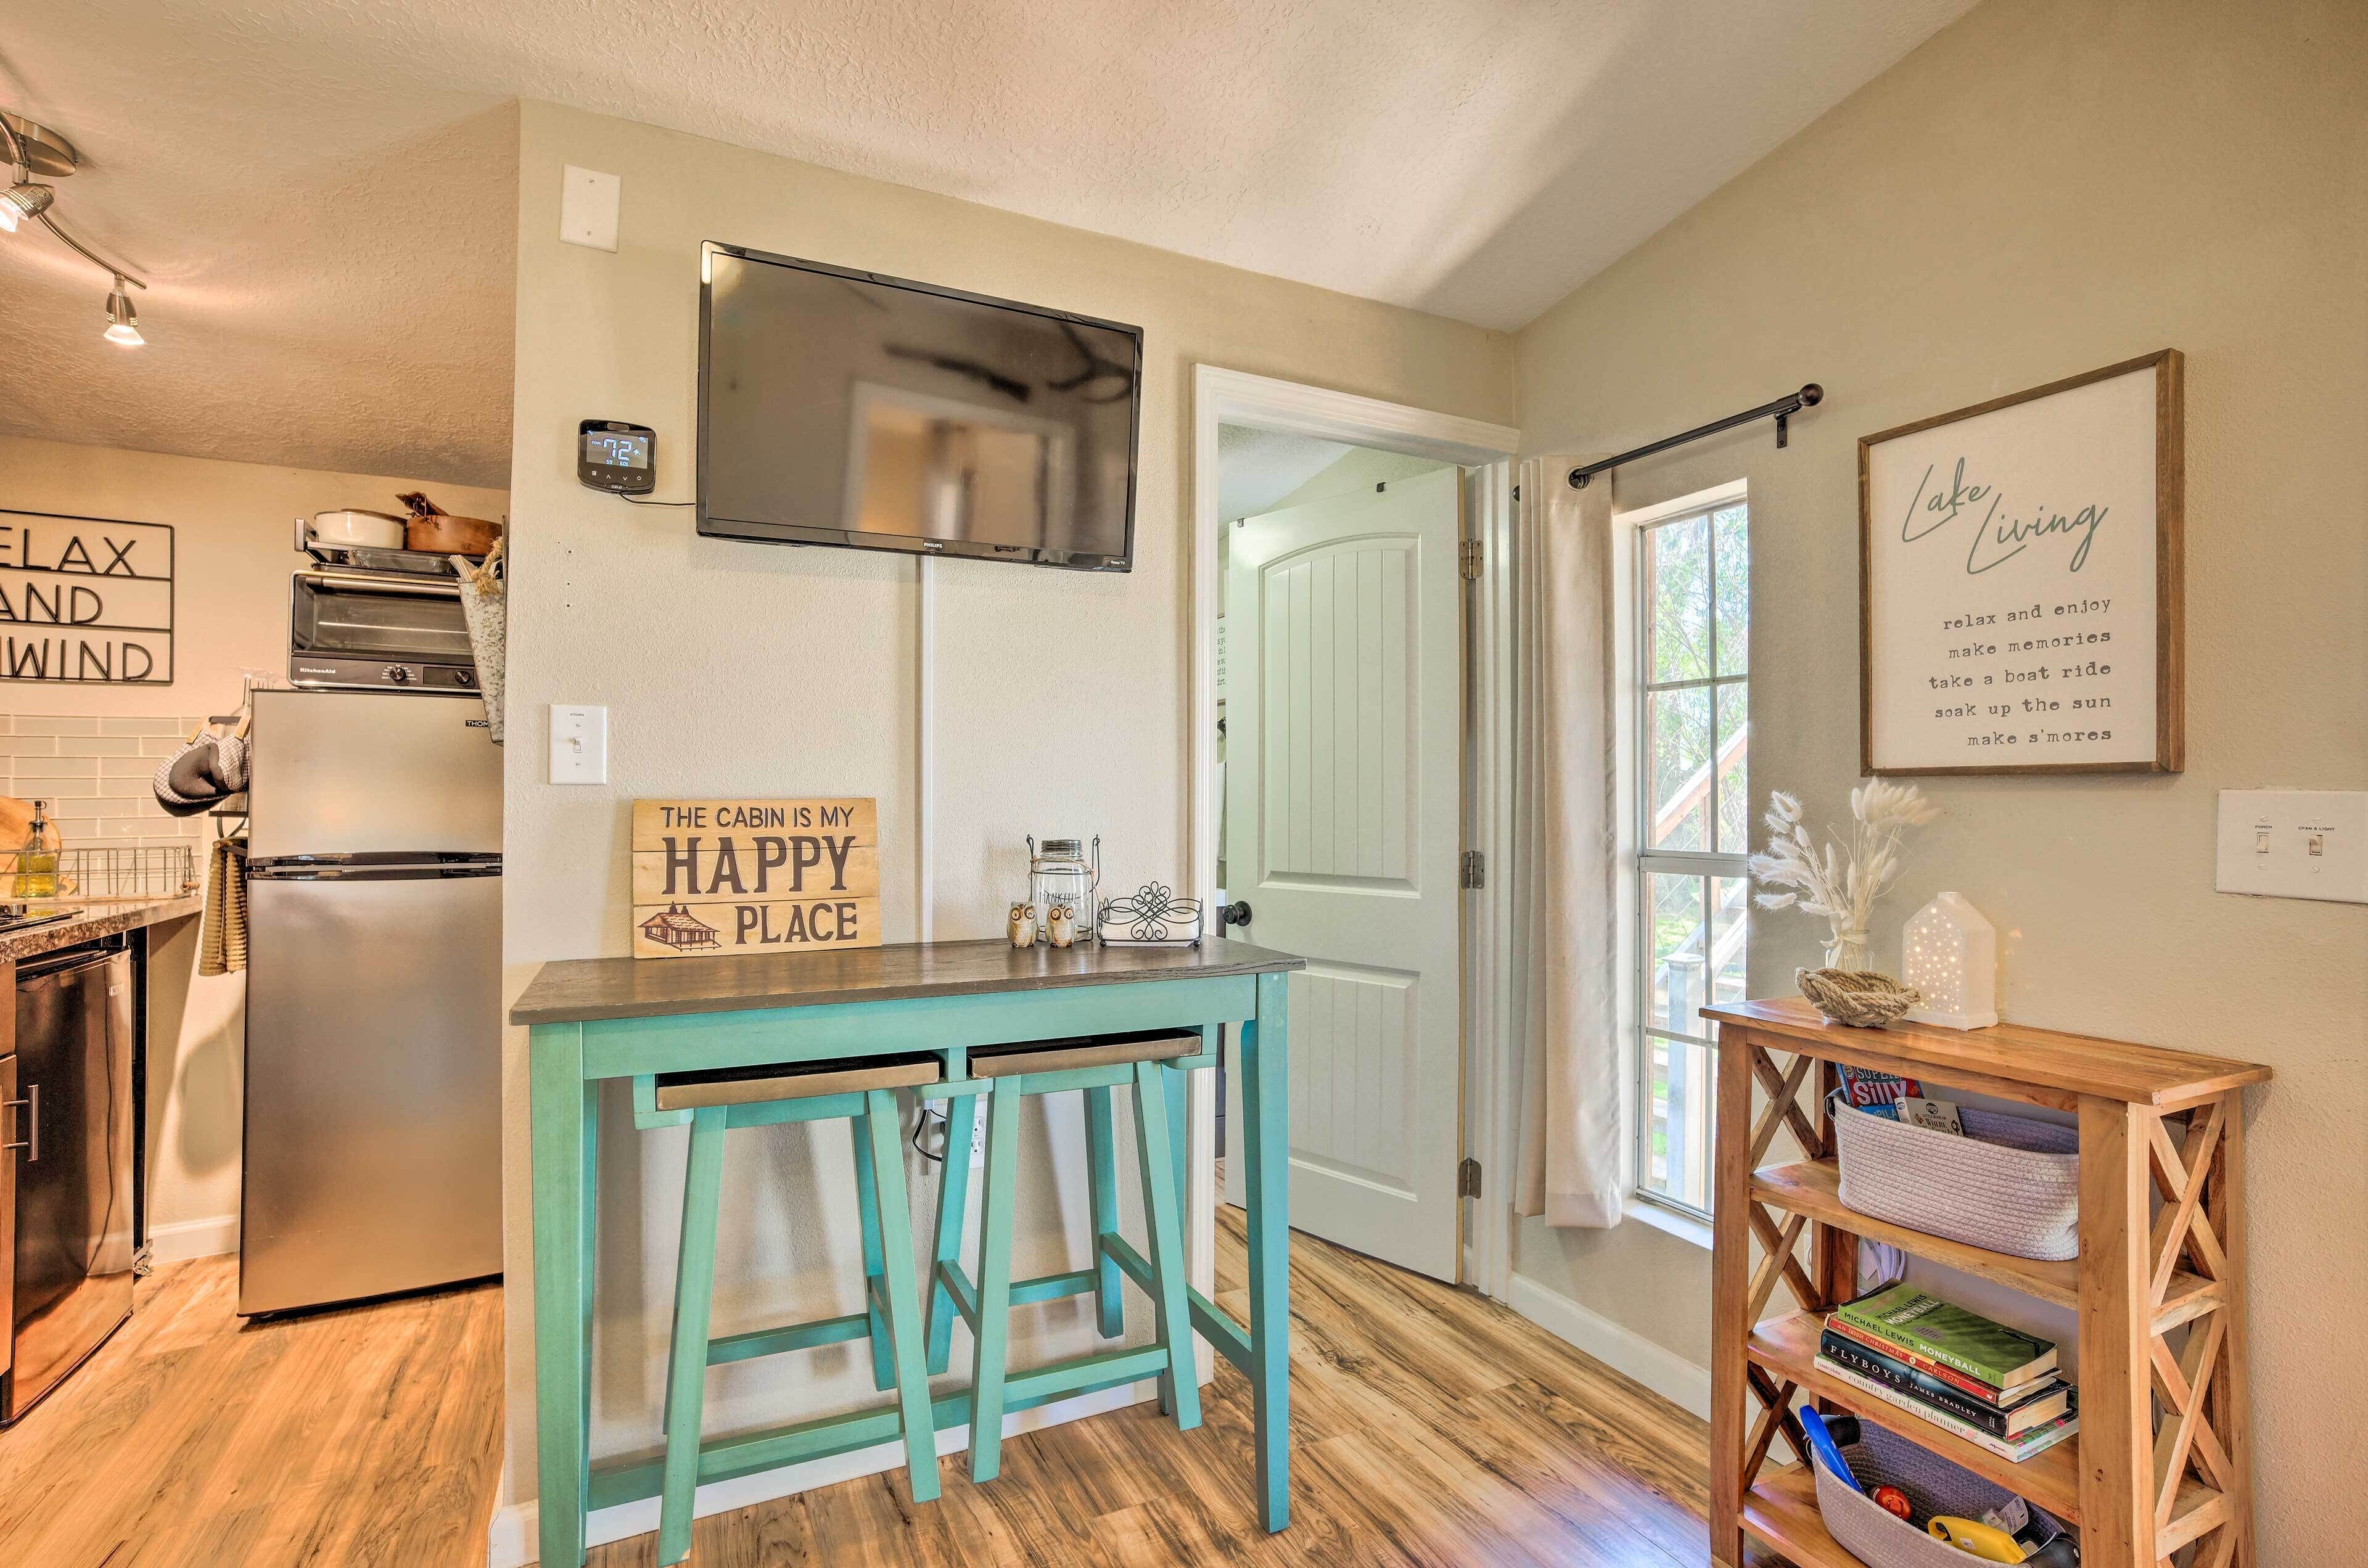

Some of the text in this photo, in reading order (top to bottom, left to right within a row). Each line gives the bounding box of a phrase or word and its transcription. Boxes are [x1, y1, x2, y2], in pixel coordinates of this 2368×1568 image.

[603, 438, 632, 461] 72
[1902, 458, 1991, 543] Lake
[1967, 493, 2108, 575] Living
[1943, 597, 2111, 630] relax and enjoy
[0, 636, 153, 681] WIND
[1949, 631, 2111, 659] make memories
[1929, 662, 2111, 689] take a boat ride
[1935, 697, 2111, 718] soak up the sun
[1968, 729, 2111, 746] make s'mores
[660, 805, 854, 828] THE CABIN IS MY
[661, 835, 856, 895] HAPPY
[734, 903, 857, 945] PLACE
[1874, 1109, 1897, 1119] PILA
[1925, 1118, 1947, 1128] WHERE
[1875, 1306, 1907, 1320] MICHAEL
[1904, 1294, 1927, 1308] LEWIS
[1884, 1299, 1940, 1325] MONEYBALL
[1837, 1324, 1960, 1385] AN IRISH CHRISTMAS CARLSON
[1844, 1312, 1883, 1334] MICHAEL
[1885, 1329, 1914, 1347] LEWIS
[1920, 1344, 1981, 1376] MONEYBALL
[1830, 1345, 1977, 1417] FLYBOYS JAMES BRADLEY
[1849, 1374, 1966, 1434] country garden planner
